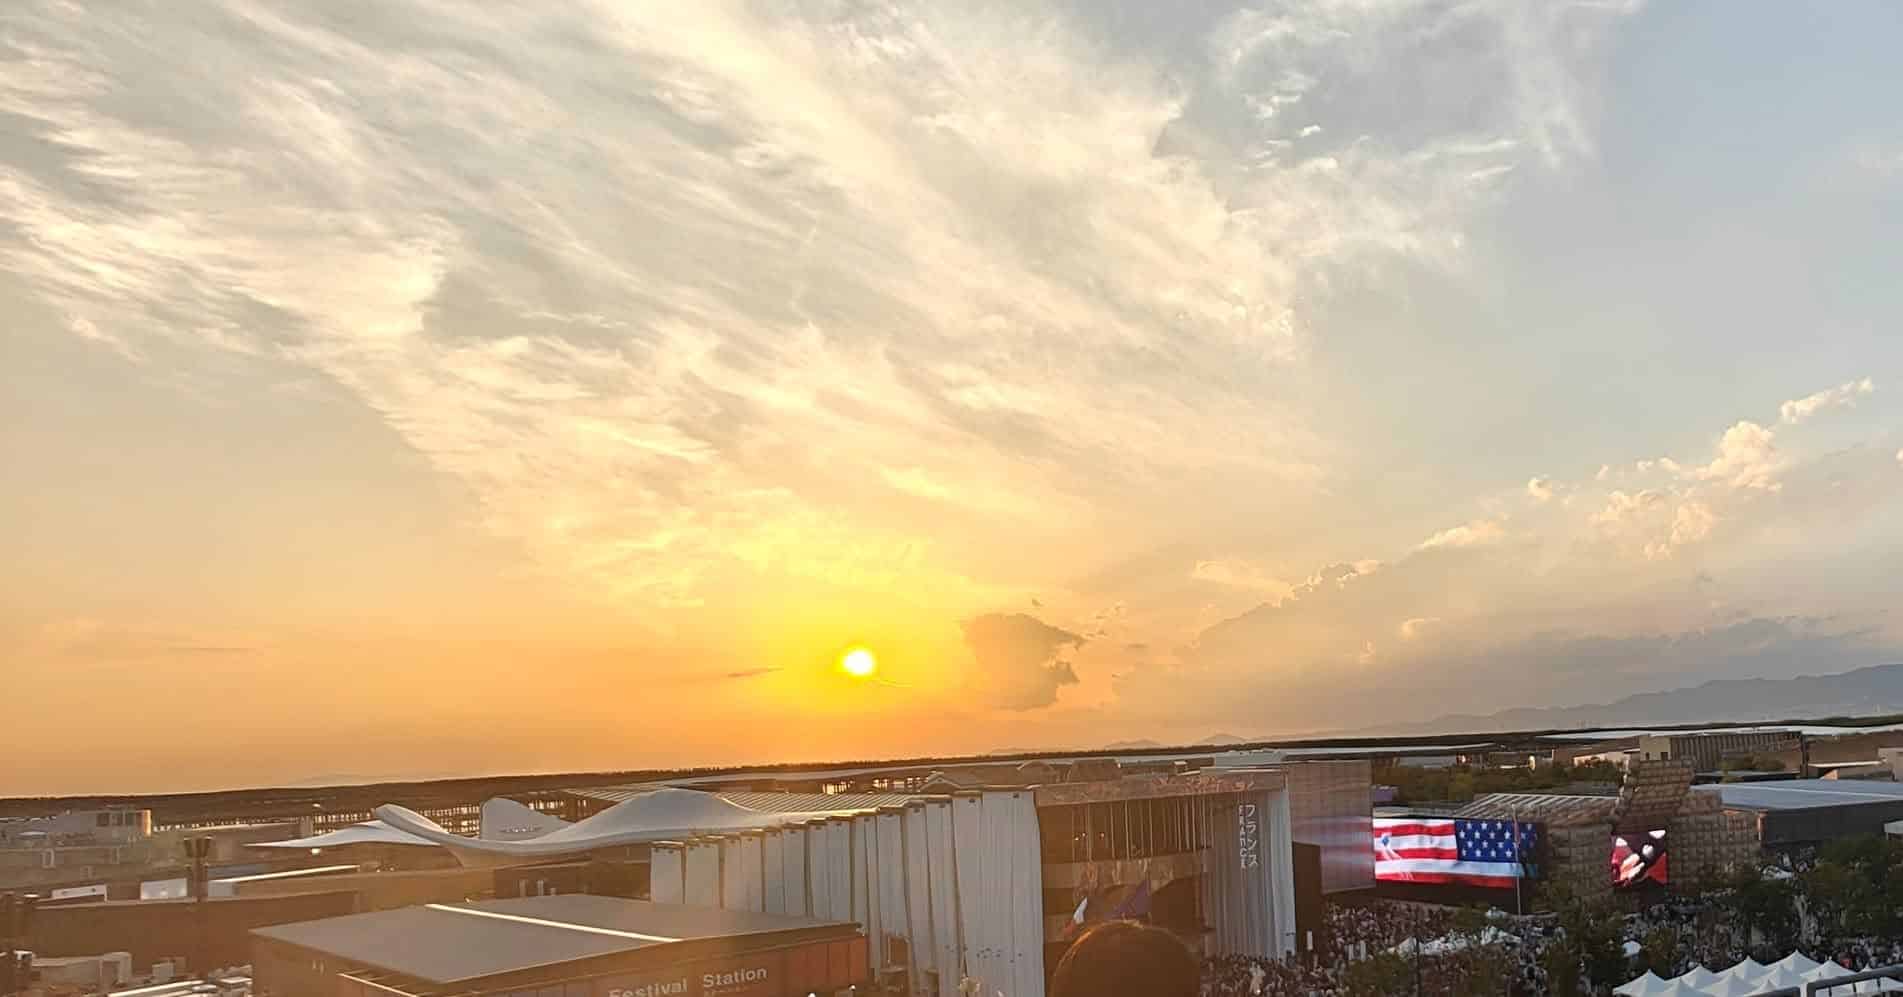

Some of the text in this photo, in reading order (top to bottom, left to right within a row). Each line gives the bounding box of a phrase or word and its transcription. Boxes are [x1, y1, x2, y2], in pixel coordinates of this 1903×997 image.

[1245, 804, 1257, 866] フランス
[703, 967, 768, 988] Station
